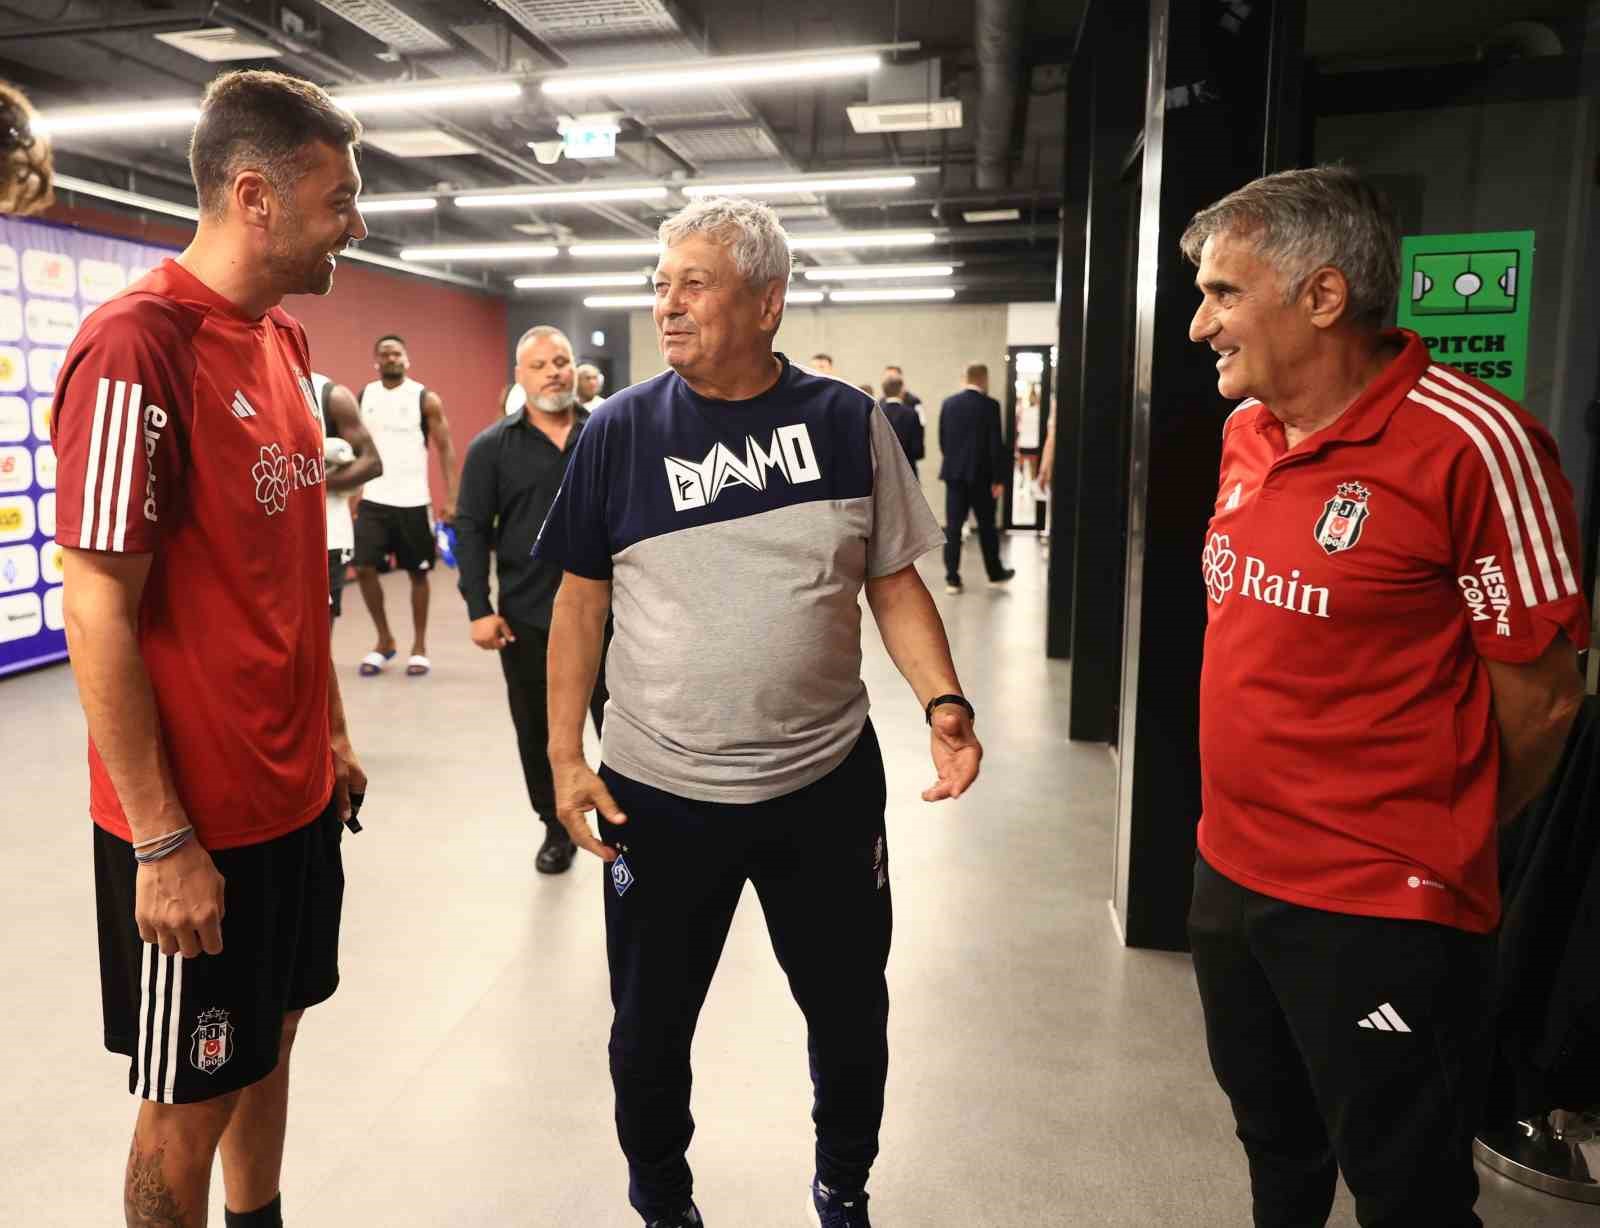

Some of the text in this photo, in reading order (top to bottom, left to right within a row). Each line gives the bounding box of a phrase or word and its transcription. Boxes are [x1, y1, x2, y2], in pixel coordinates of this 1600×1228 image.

[1422, 335, 1505, 353] PITCH
[1449, 361, 1512, 378] ESS
[1240, 556, 1330, 618] Rain
[1457, 575, 1492, 622] COM
[1474, 555, 1511, 637] NESINE
